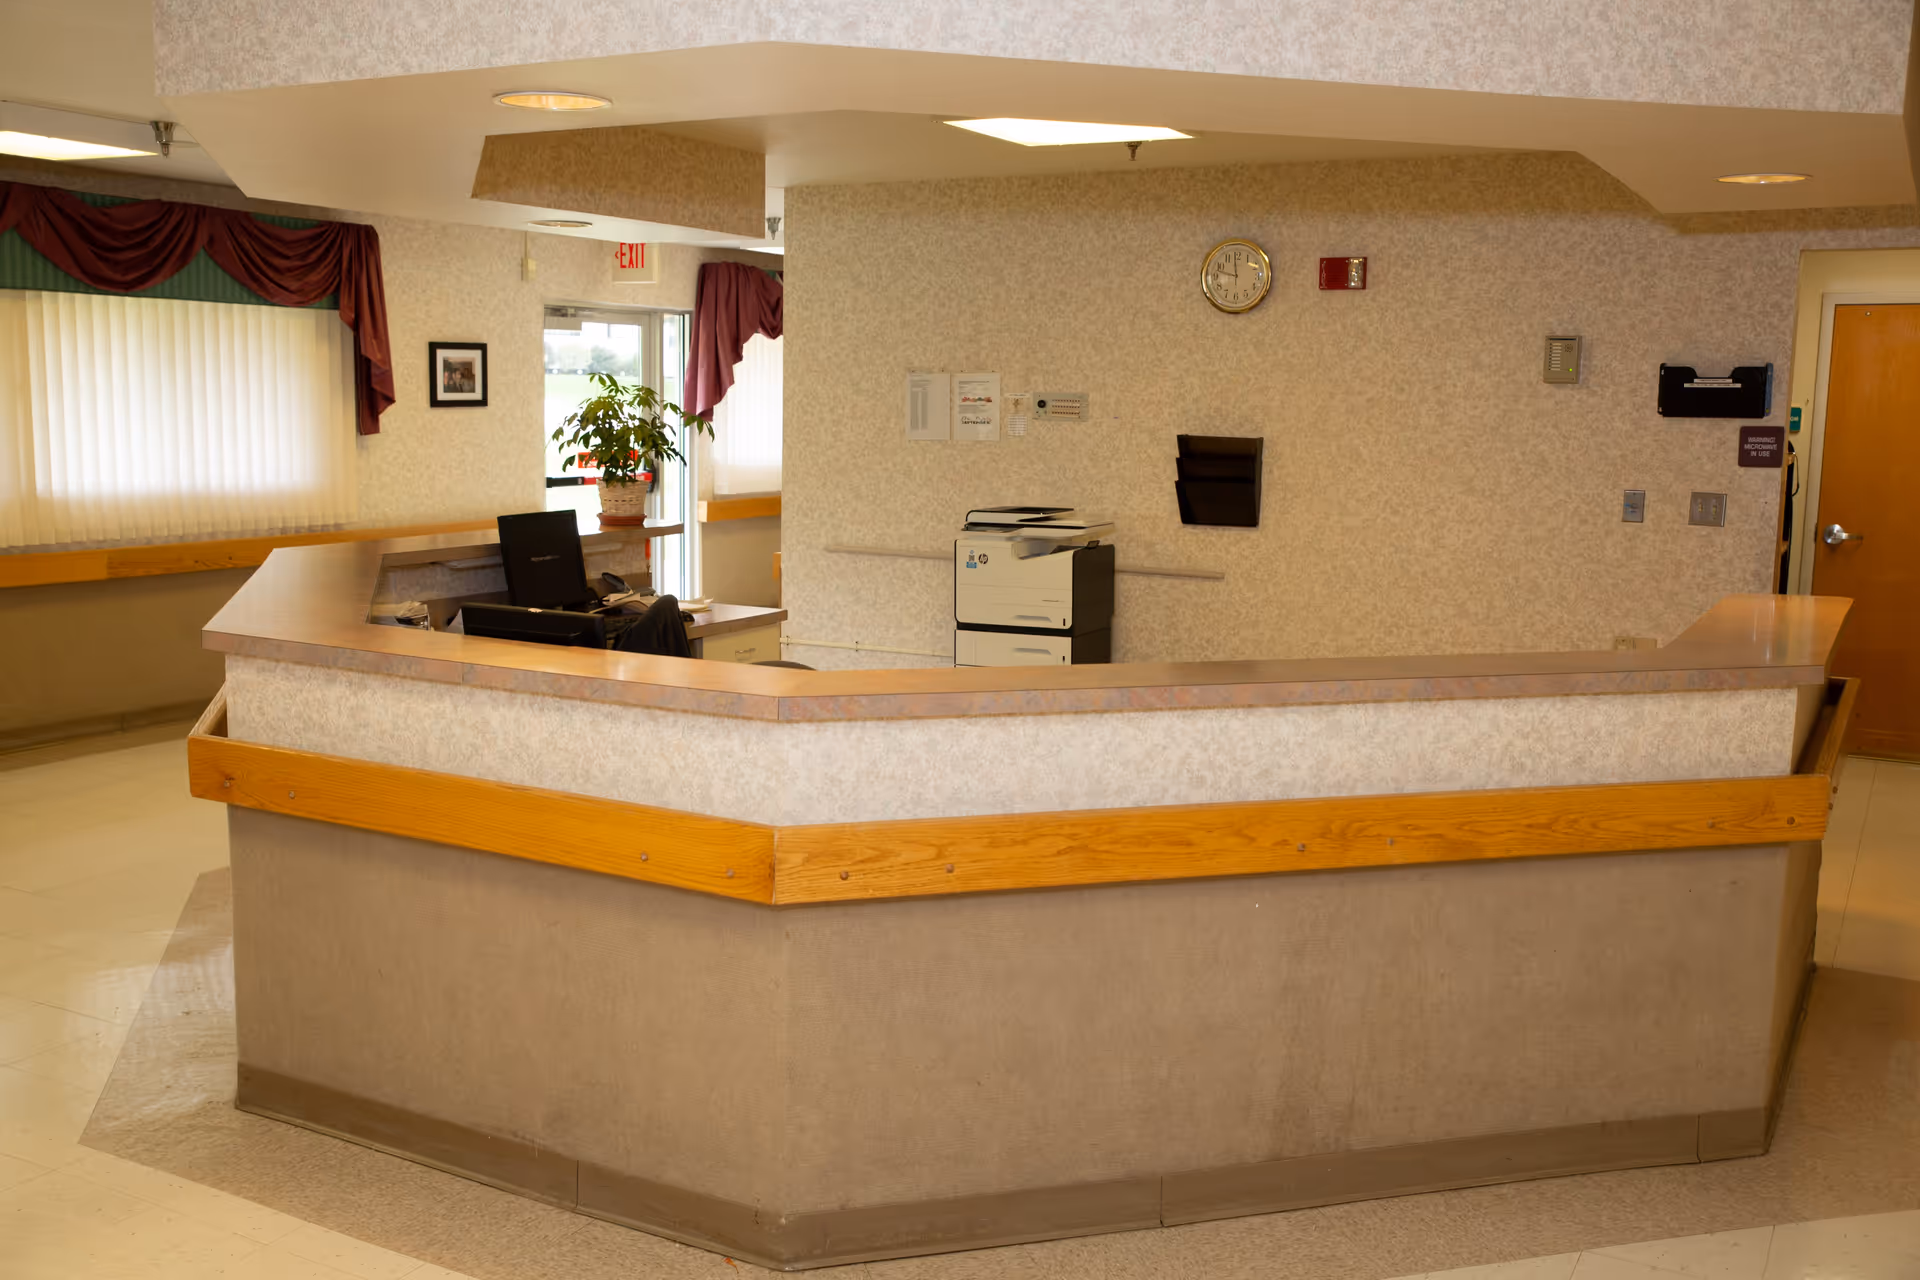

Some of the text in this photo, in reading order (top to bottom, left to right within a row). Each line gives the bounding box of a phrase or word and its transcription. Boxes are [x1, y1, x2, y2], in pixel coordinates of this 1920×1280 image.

[620, 242, 646, 268] EXIT
[1217, 262, 1224, 271] 10
[978, 553, 989, 565] hp
